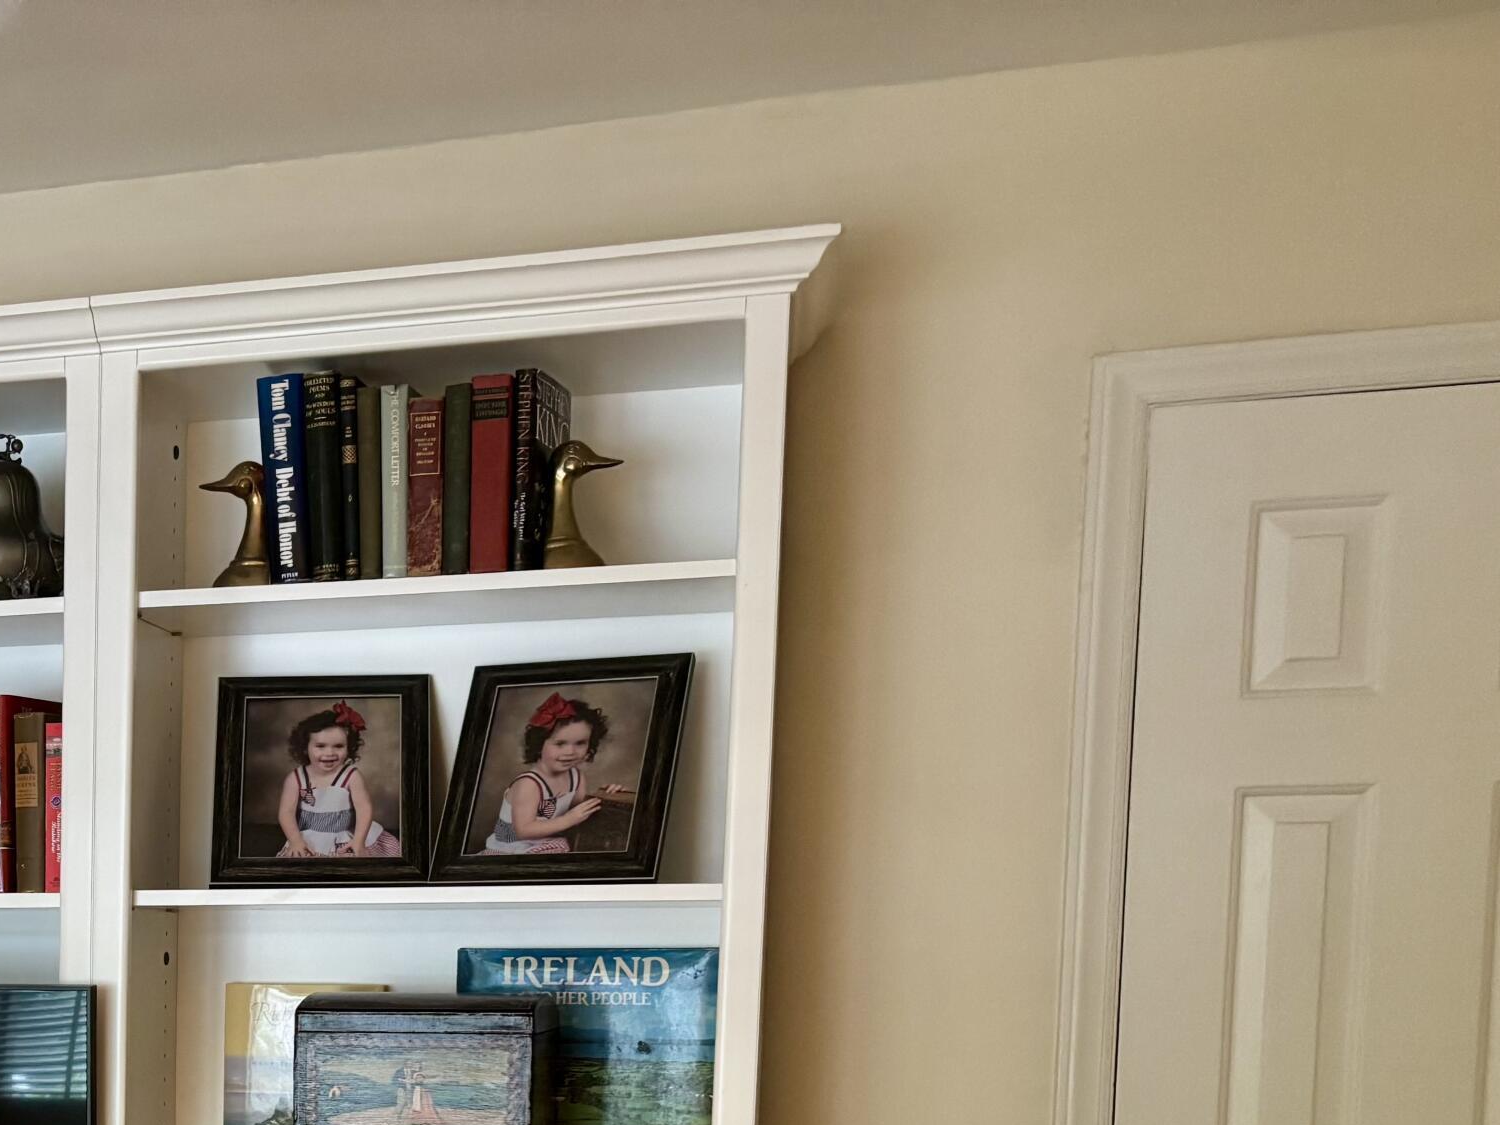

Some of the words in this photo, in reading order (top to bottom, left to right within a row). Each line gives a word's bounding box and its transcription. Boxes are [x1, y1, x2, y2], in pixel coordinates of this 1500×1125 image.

[271, 378, 289, 411] Tom
[390, 391, 399, 406] THE
[519, 373, 531, 440] STEPHEN
[269, 413, 292, 462] Clancy
[391, 409, 399, 454] COMFORT
[391, 455, 399, 486] LETTER
[516, 446, 530, 484] KING
[275, 467, 296, 508] Debt
[277, 505, 296, 523] of
[278, 520, 297, 567] Honor
[501, 955, 671, 988] IRELAND
[557, 990, 589, 1006] HER
[591, 990, 652, 1006] PEOPLE
